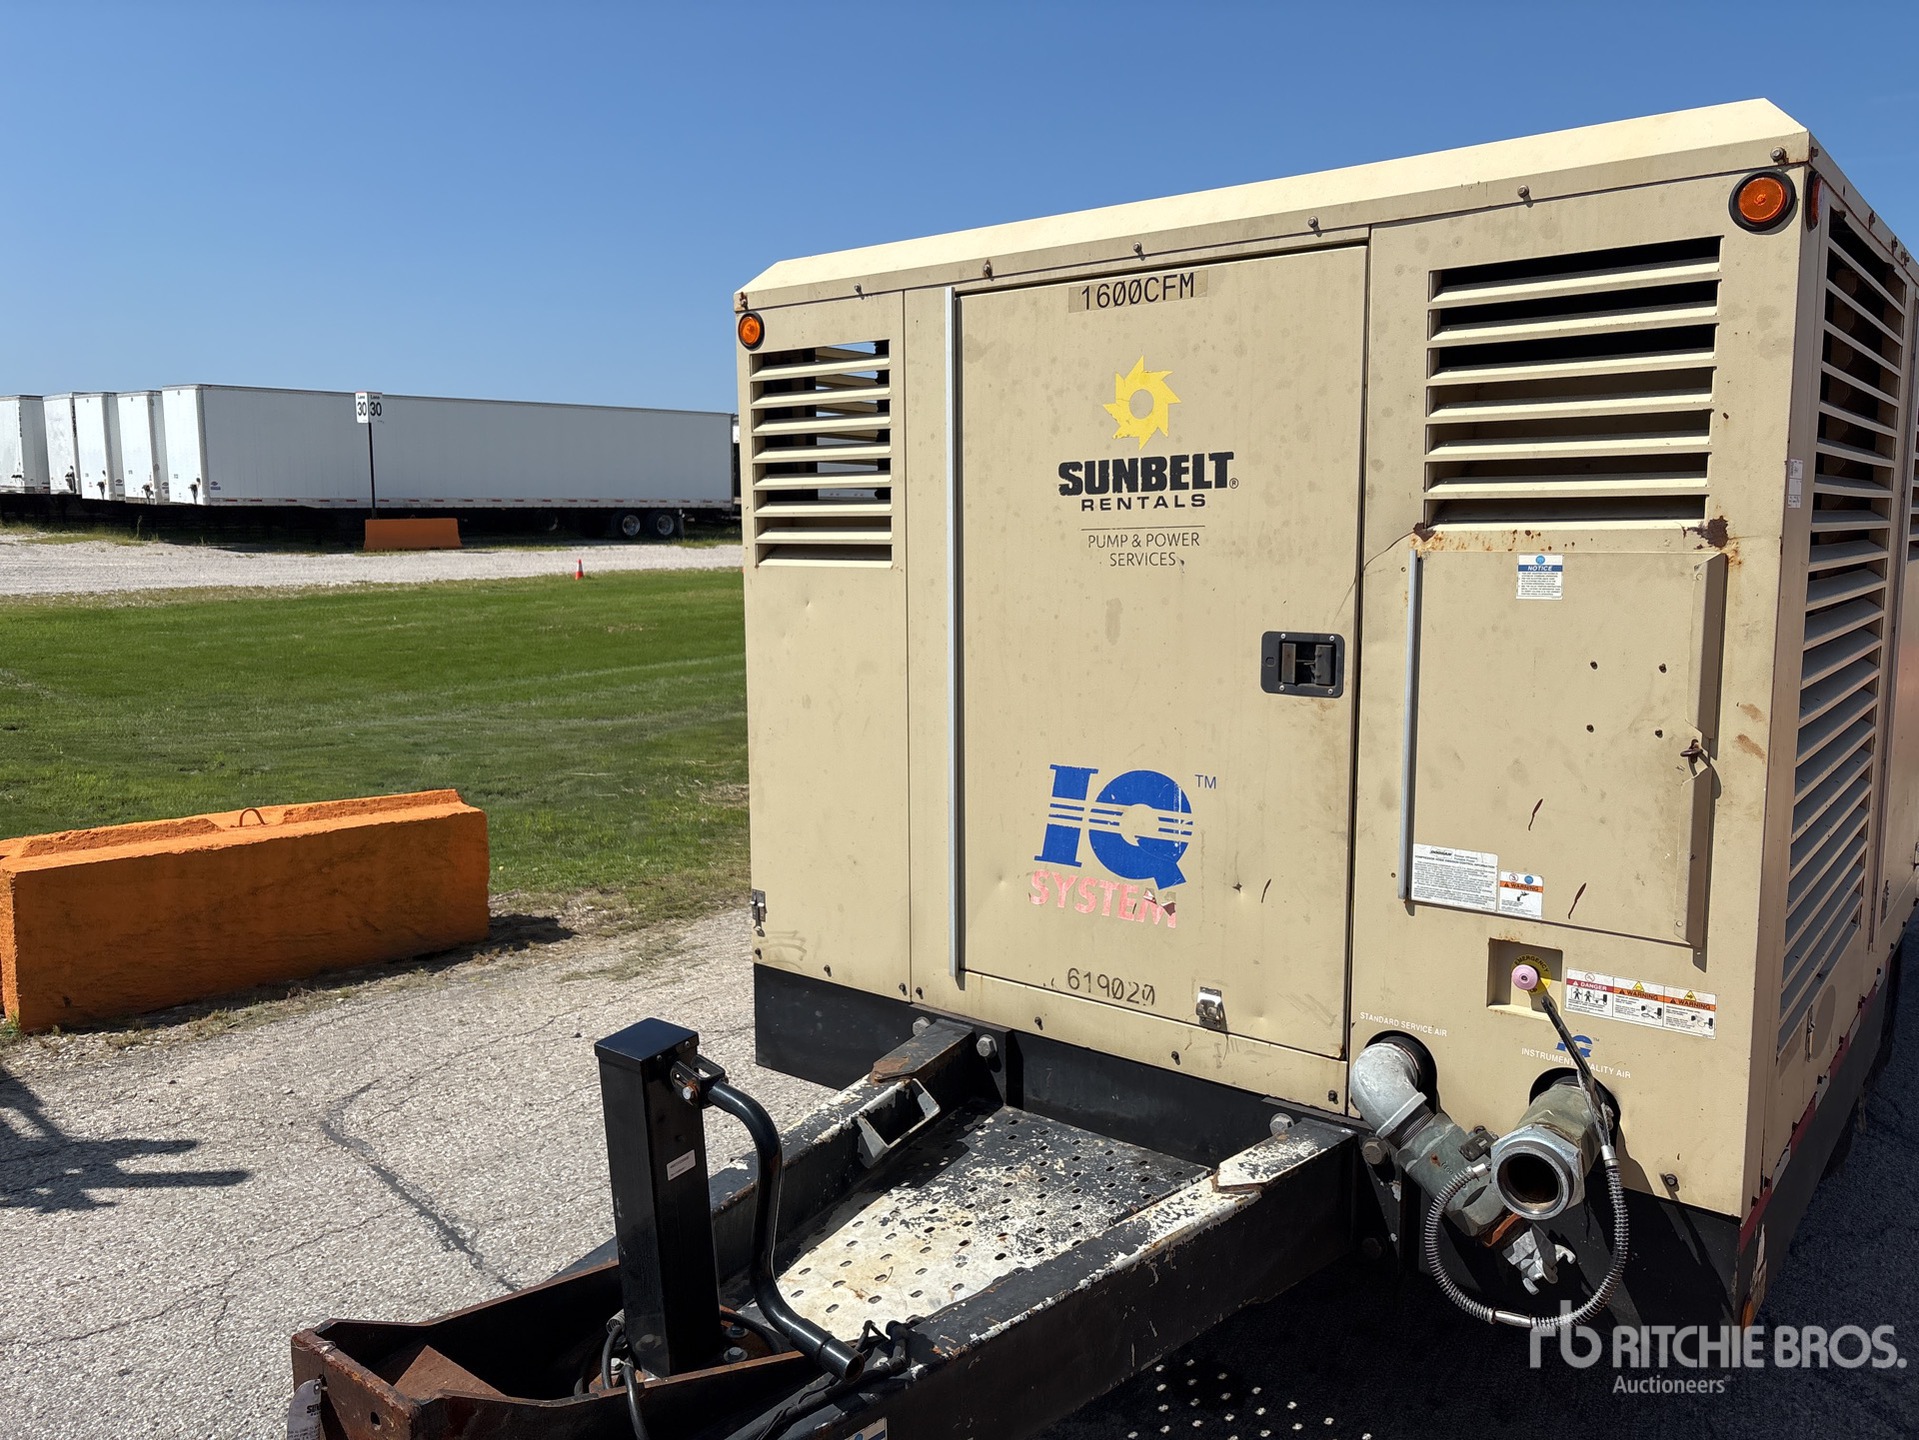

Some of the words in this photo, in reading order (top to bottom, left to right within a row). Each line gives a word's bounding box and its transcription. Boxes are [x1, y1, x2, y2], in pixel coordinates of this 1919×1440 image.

[1081, 272, 1195, 310] 1600CFM
[358, 402, 367, 416] 30
[370, 401, 382, 416] 30
[1081, 493, 1206, 512] RENTALS
[1088, 534, 1128, 549] PUMP
[1131, 534, 1142, 547] &
[1146, 532, 1200, 547] POWER
[1109, 552, 1176, 567] SERVICES
[1034, 763, 1194, 890] IQ
[1511, 882, 1539, 892] WARNING
[1029, 869, 1176, 929] SYSTEM
[1514, 955, 1549, 972] EMERGENCY
[1580, 981, 1607, 991] DANGER
[1627, 990, 1659, 1001] WARNING
[1679, 999, 1711, 1010] WARNING
[1360, 1011, 1400, 1027] STANDARD
[1400, 1020, 1433, 1034] SERVICE
[1433, 1028, 1448, 1037] AIR
[1521, 1047, 1575, 1066] INSTRUMENT
[1616, 1069, 1631, 1079] AIR
